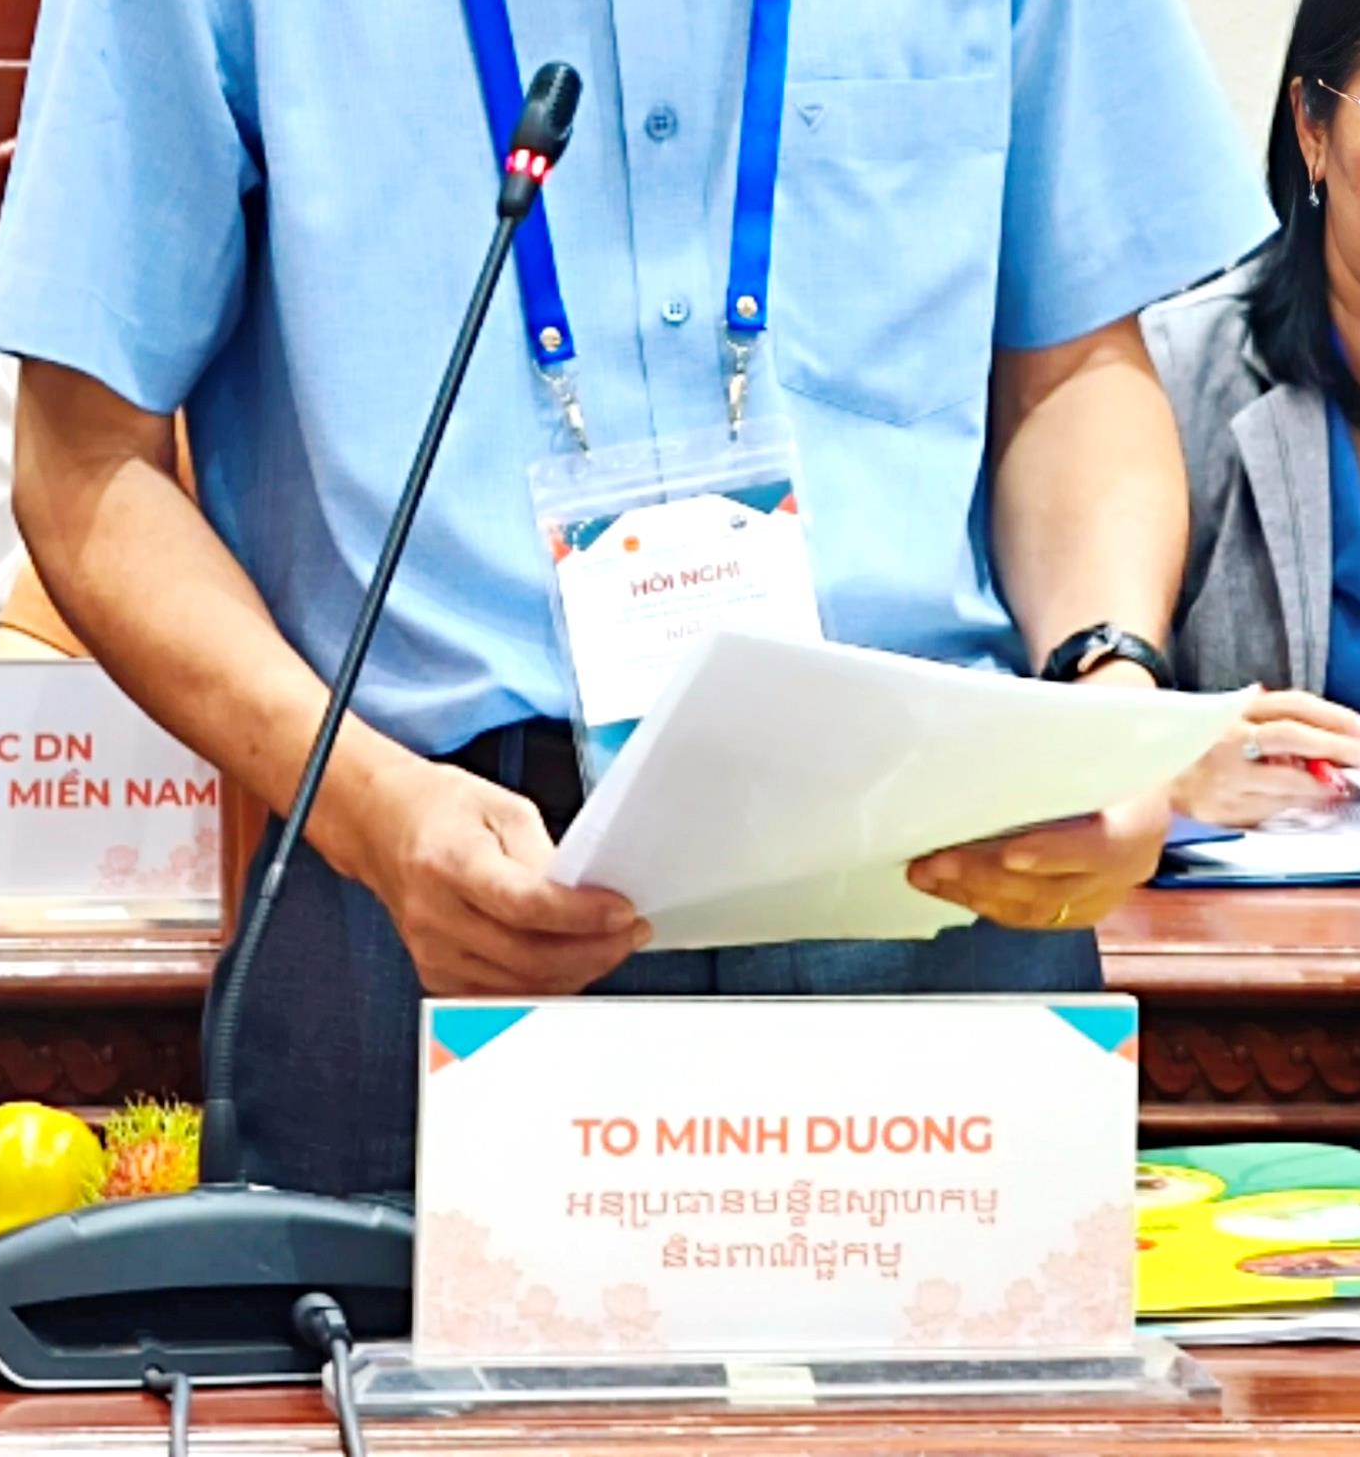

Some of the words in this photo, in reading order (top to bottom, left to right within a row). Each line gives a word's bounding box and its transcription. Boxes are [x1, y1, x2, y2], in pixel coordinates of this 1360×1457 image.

[34, 733, 94, 763] DN
[8, 768, 111, 808] MIỀN
[125, 778, 217, 808] NAM
[572, 1118, 639, 1157] TO
[655, 1117, 789, 1155] MINH
[806, 1116, 993, 1154] DUONG
